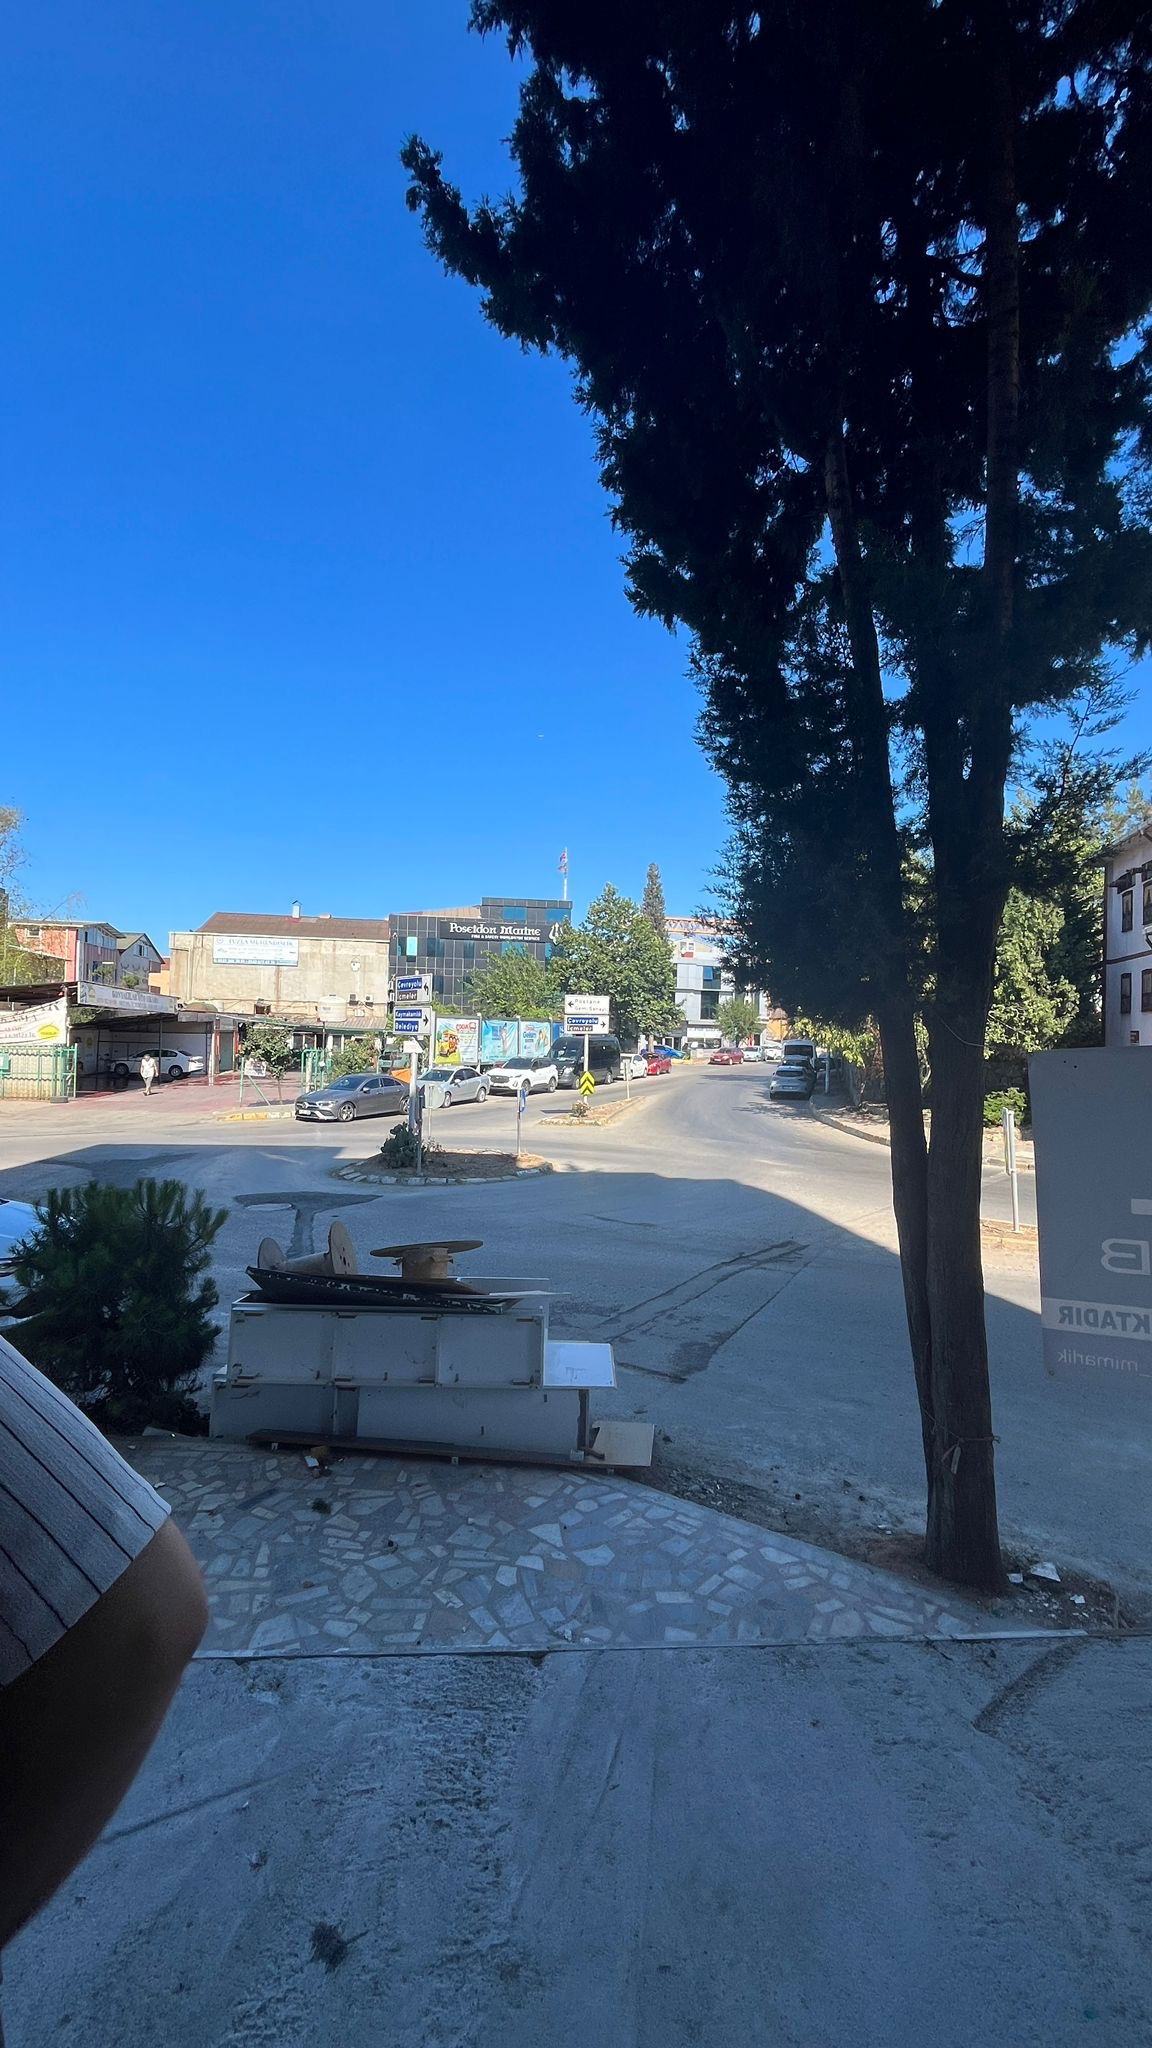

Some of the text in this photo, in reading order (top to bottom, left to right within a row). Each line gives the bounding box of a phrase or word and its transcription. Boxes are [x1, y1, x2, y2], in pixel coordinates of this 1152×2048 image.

[449, 922, 541, 936] Poseidon Marine
[395, 1022, 418, 1032] Belediye
